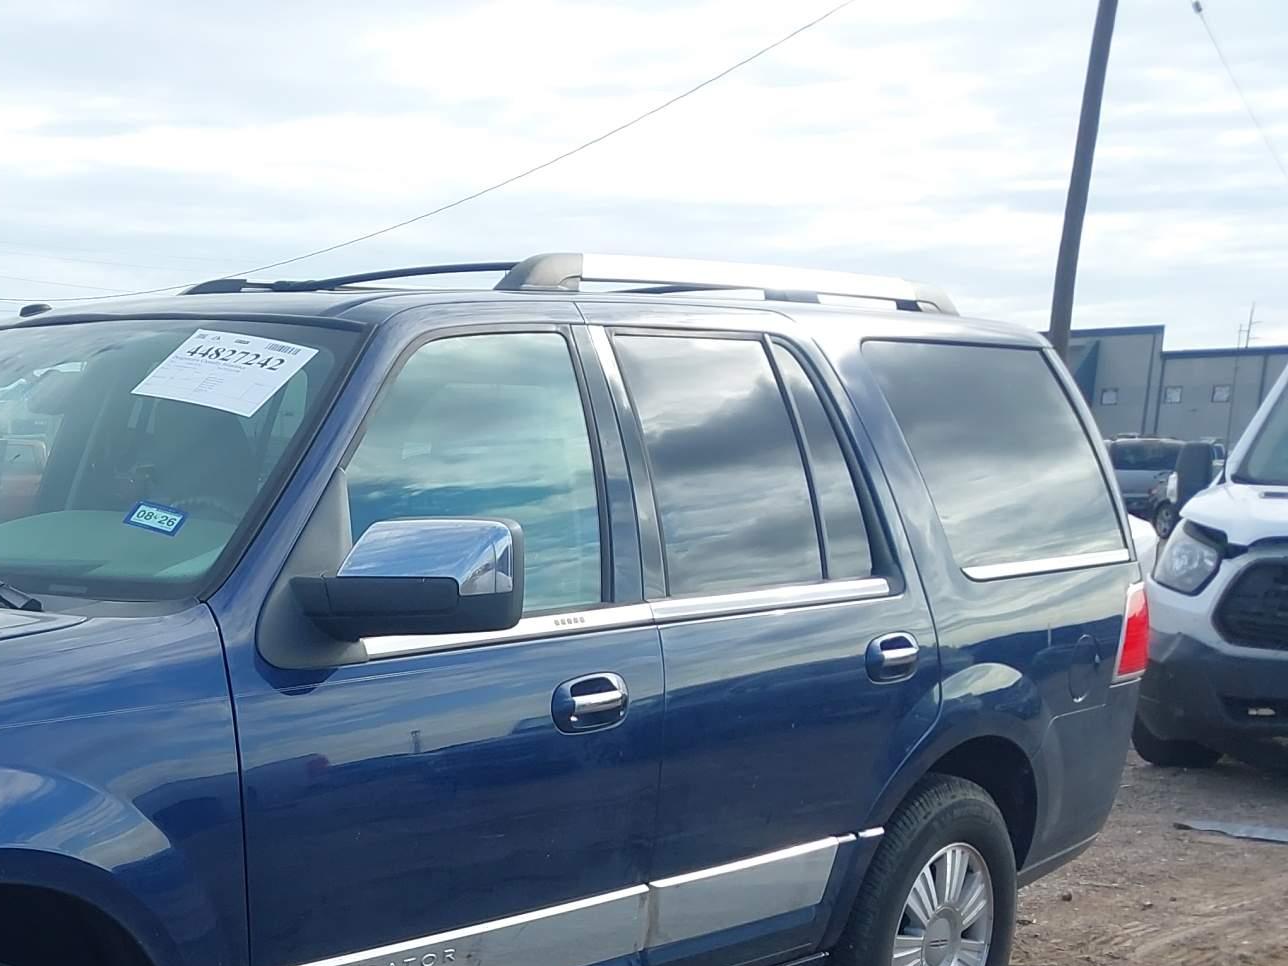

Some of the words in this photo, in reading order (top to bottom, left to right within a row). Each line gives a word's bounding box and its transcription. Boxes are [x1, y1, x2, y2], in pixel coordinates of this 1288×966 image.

[185, 344, 286, 372] 44827242
[136, 509, 155, 521] 08
[157, 515, 177, 527] 26
